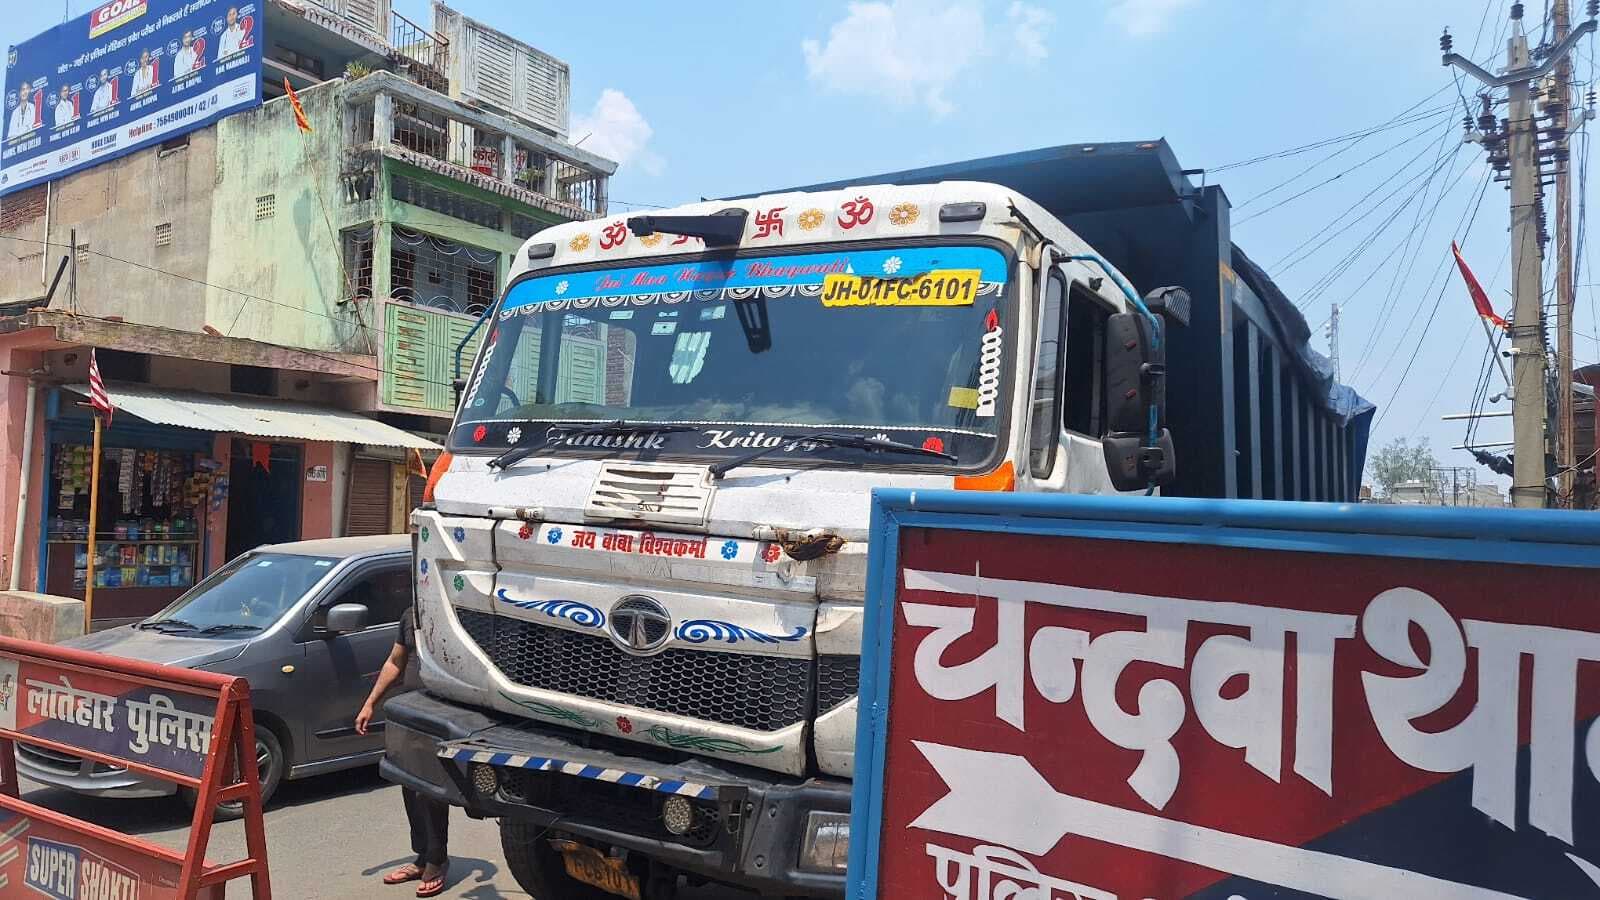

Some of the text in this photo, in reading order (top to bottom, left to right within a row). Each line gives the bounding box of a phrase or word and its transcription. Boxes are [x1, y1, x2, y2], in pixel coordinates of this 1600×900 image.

[824, 277, 972, 301] JH-01FC-6101
[571, 530, 710, 558] जय बाबा विश्वकर्मा
[25, 676, 215, 755] लातेहार पुलिस
[901, 567, 1600, 847] चन्दवा था
[29, 843, 77, 898] SUPER
